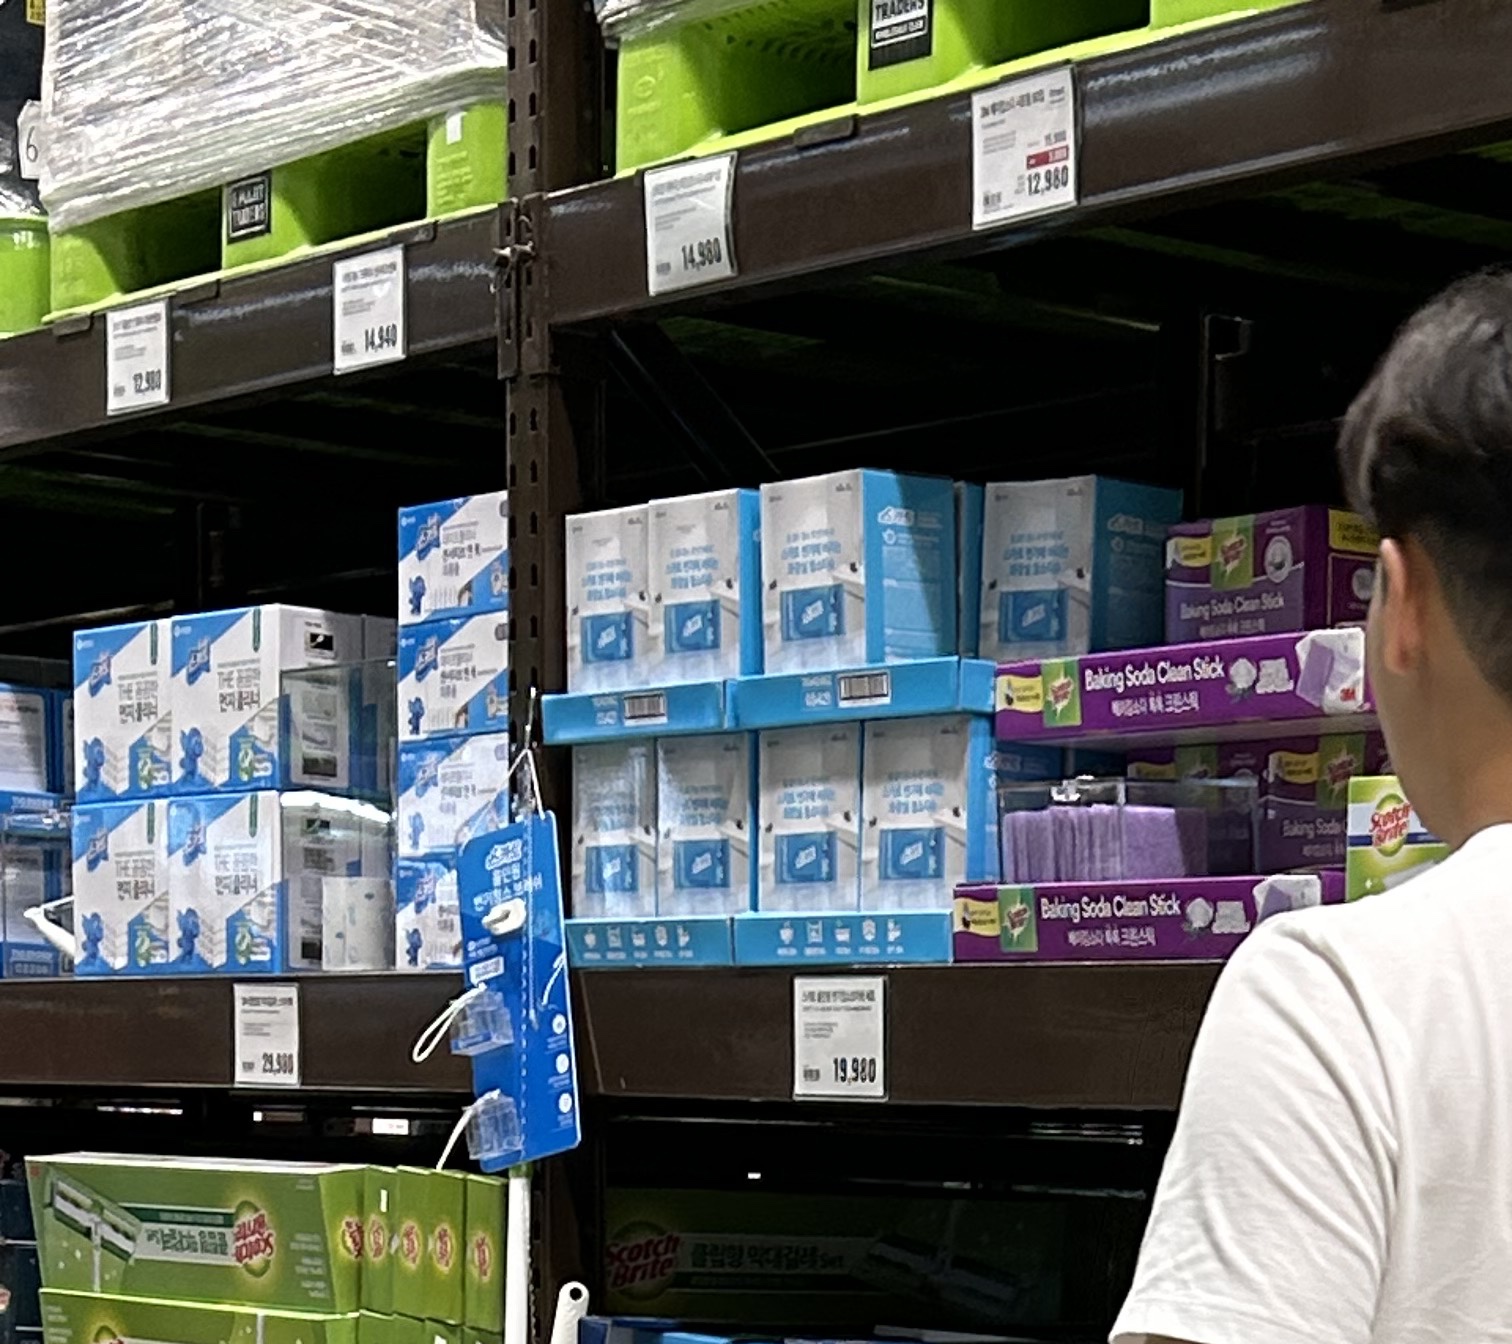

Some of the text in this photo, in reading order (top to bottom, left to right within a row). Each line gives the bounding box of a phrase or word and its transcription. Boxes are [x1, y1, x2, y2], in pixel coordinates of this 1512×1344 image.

[26, 126, 38, 162] 6
[1085, 655, 1225, 693] Baking Soda Clean Stick
[1040, 893, 1180, 921] Baking Soda Clean Stick
[833, 1057, 877, 1085] 19,980
